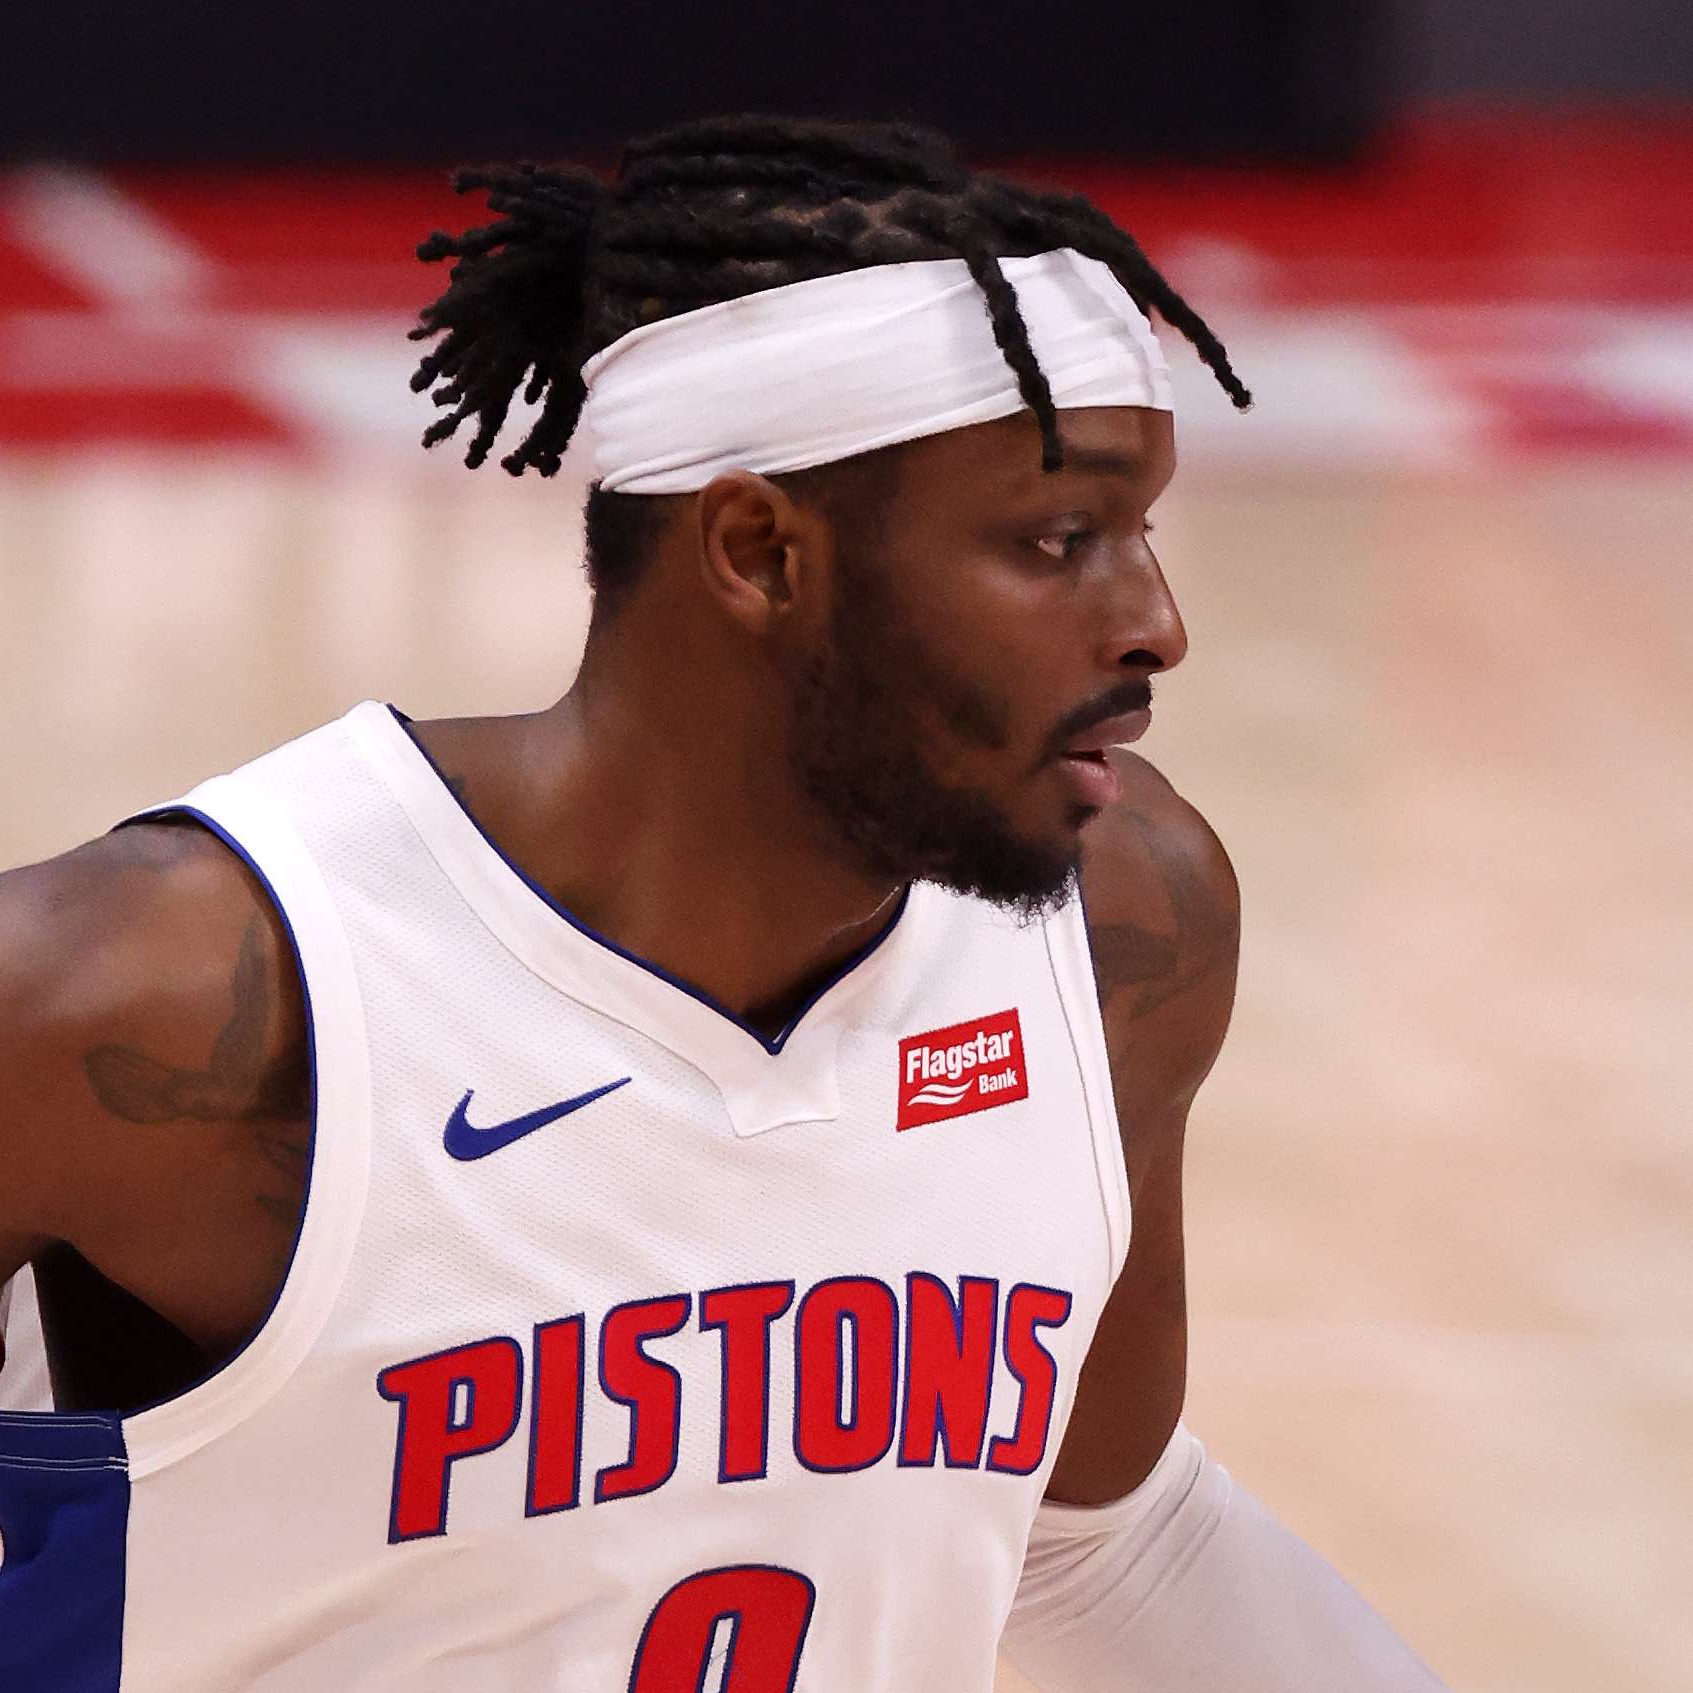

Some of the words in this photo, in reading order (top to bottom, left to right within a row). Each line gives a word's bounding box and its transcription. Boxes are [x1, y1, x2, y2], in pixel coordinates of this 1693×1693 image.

[906, 1030, 1014, 1084] Flagstar
[978, 1067, 1018, 1094] Bank
[377, 1271, 1073, 1545] PISTONS
